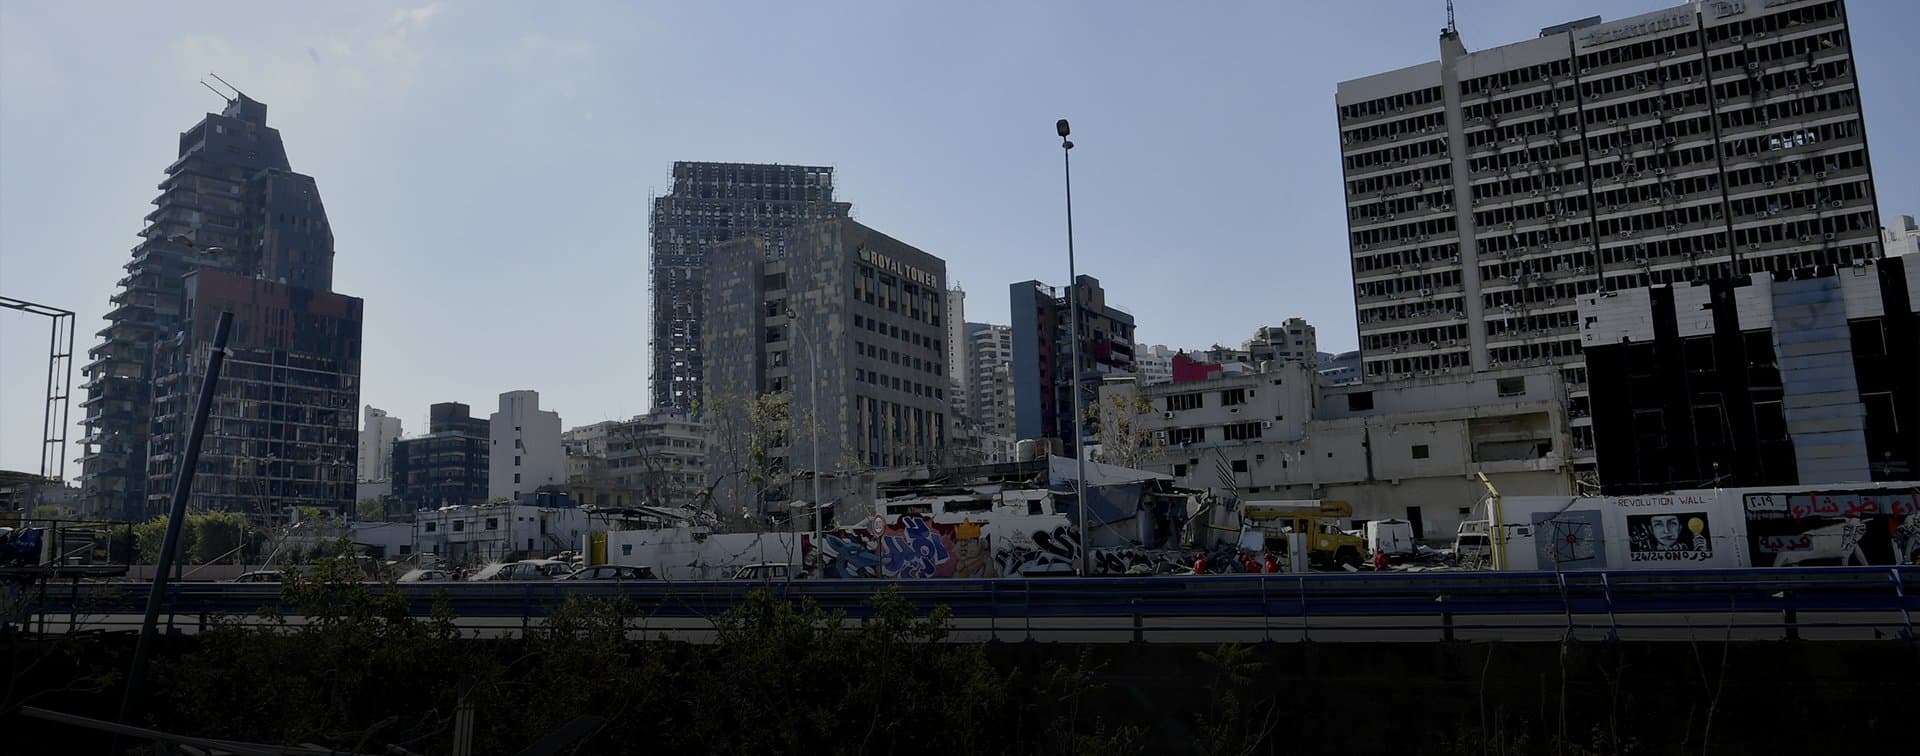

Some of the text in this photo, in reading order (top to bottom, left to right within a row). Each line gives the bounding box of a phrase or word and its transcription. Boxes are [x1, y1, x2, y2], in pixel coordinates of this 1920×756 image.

[870, 249, 937, 289] ROYAL TOWER
[1618, 496, 1704, 507] REVOLUTION WALL
[1664, 551, 1681, 560] ON
